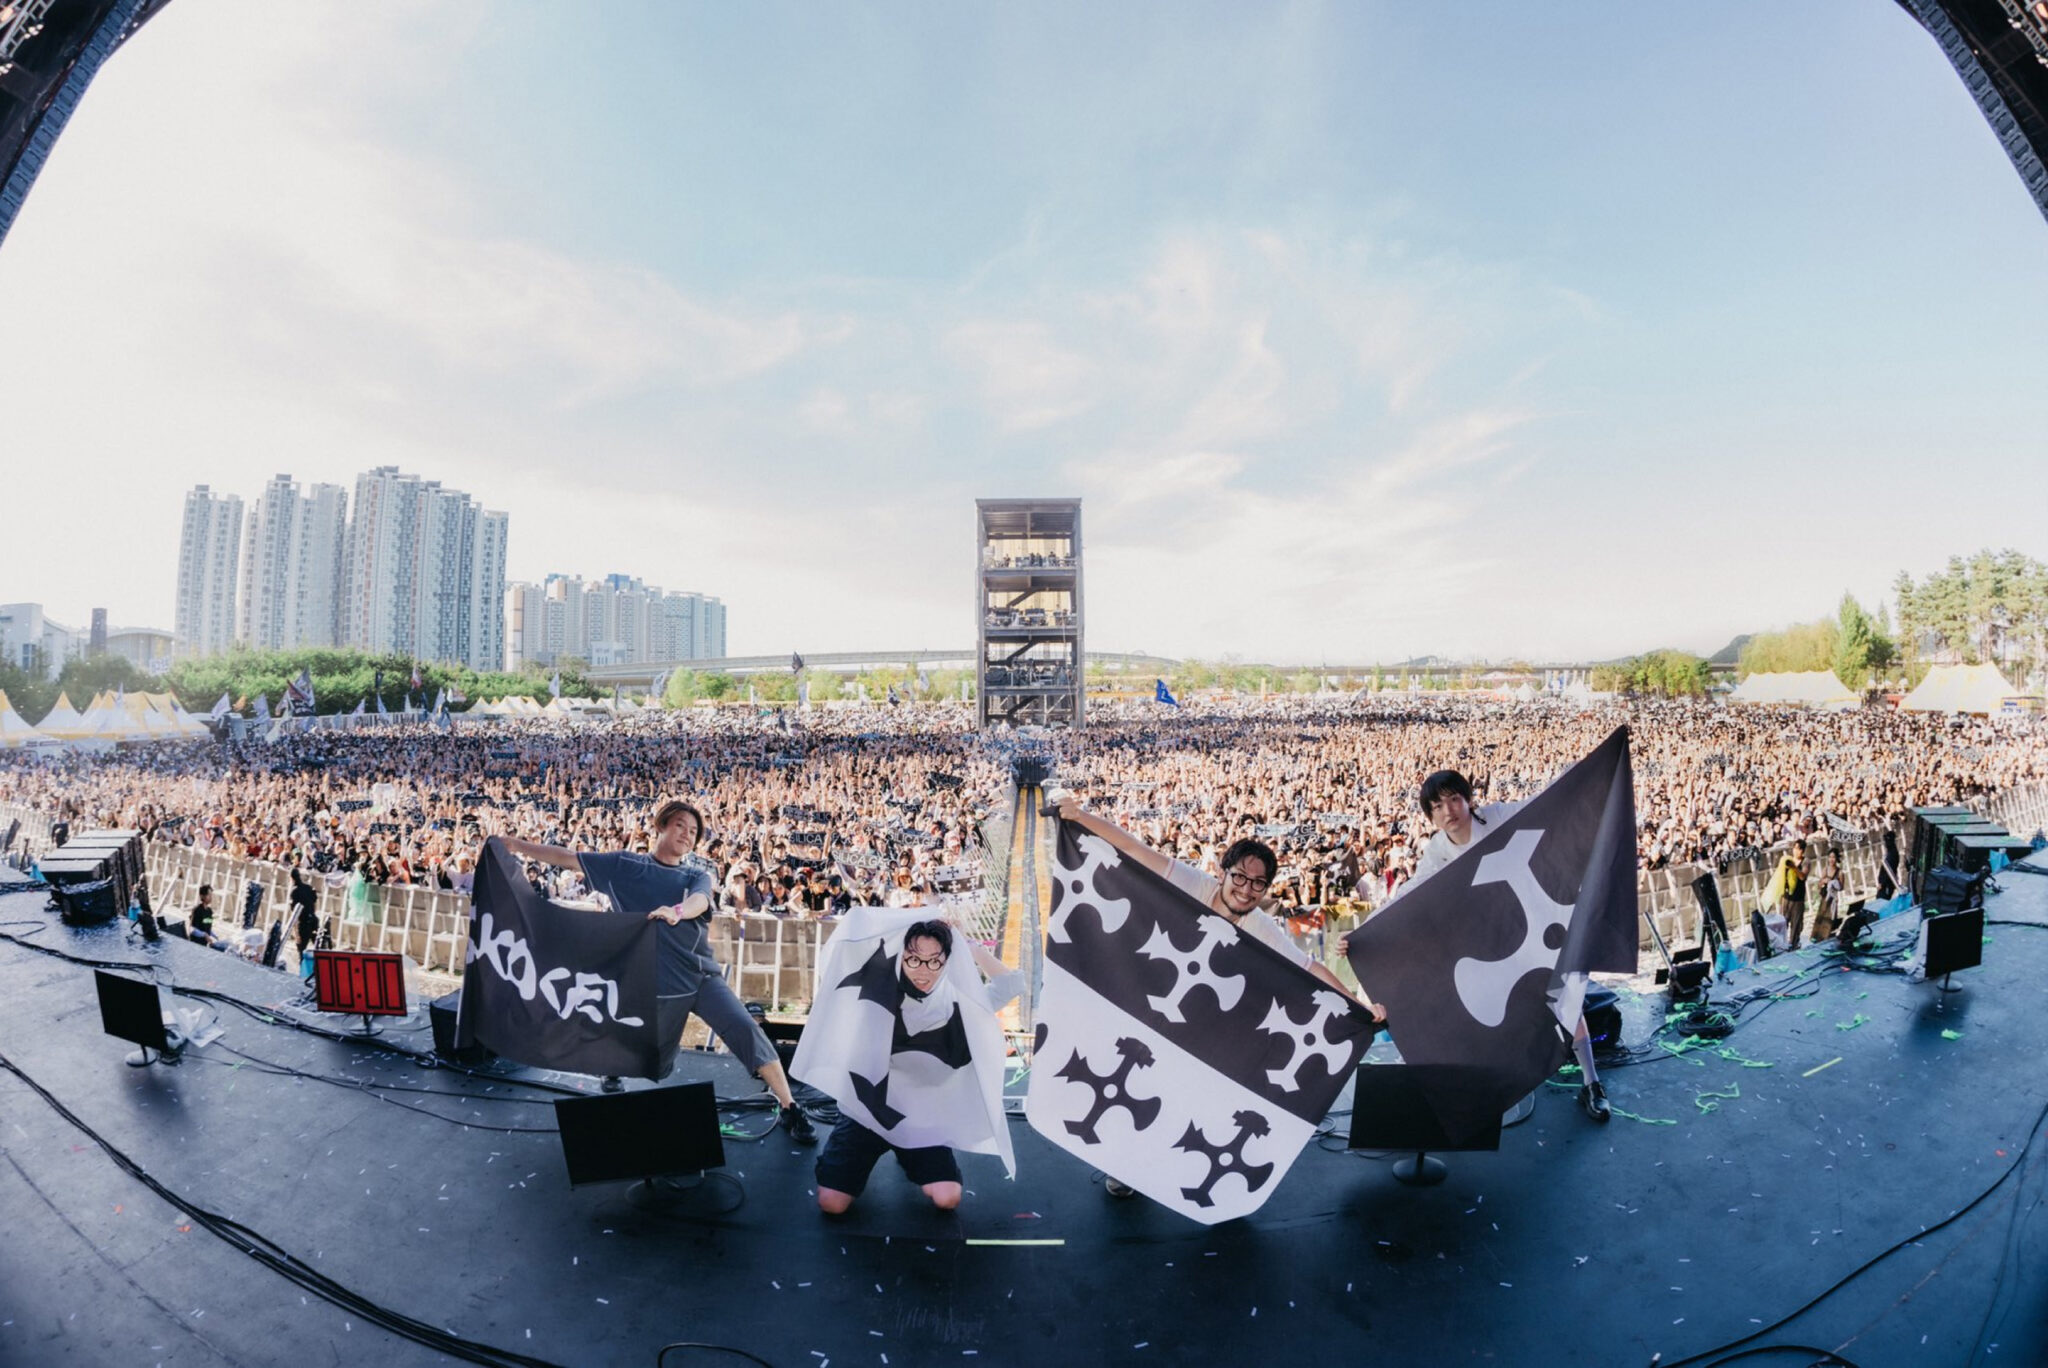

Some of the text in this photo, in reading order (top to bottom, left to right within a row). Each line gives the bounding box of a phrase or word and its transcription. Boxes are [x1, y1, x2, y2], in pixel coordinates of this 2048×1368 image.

[789, 833, 823, 845] SILICA
[887, 828, 920, 846] SILICA
[831, 850, 866, 867] SILICA
